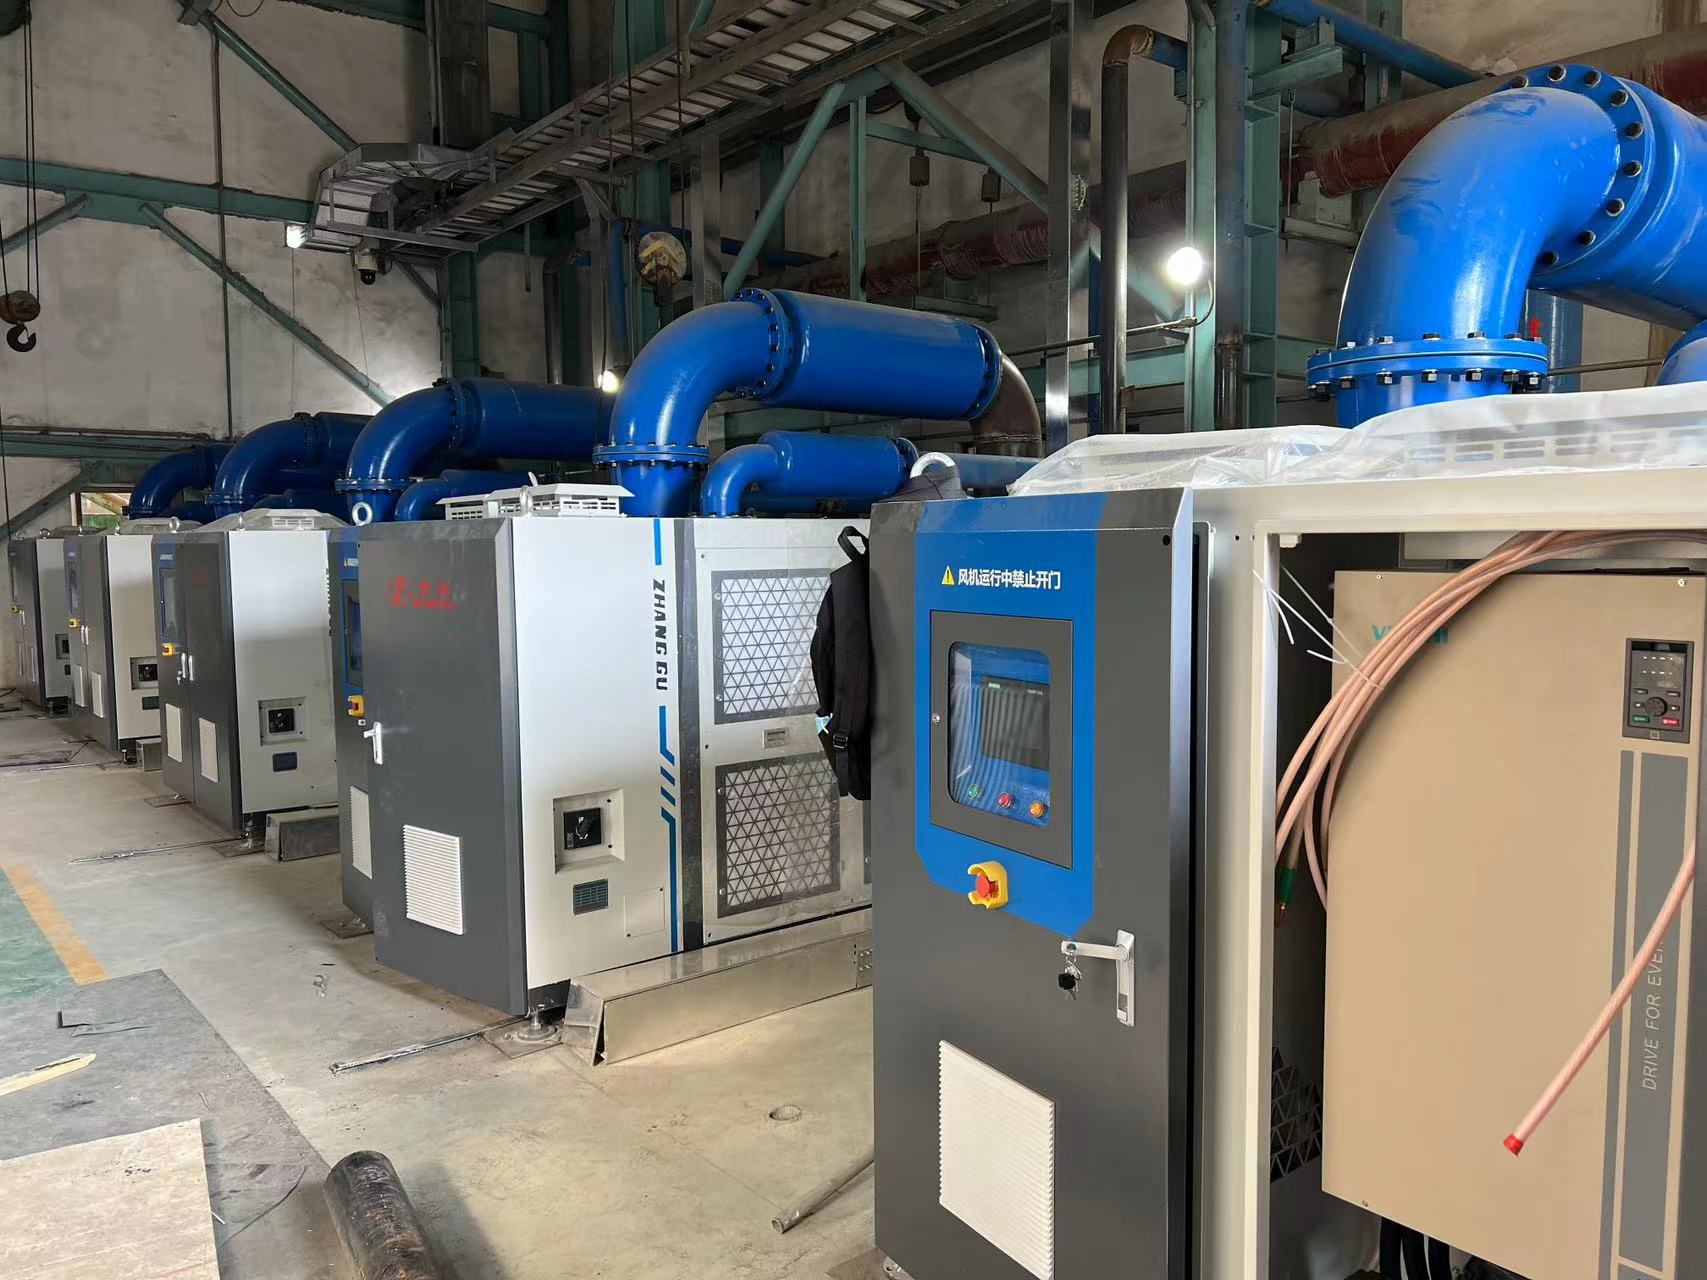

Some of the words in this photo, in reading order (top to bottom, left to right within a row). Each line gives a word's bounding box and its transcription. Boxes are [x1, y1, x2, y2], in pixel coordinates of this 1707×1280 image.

[958, 568, 1061, 590] 风机运行中禁止开门
[653, 579, 667, 655] ZHANG
[656, 661, 668, 690] GU
[1645, 994, 1661, 1030] FOR
[1642, 1037, 1659, 1090] DRIVE
